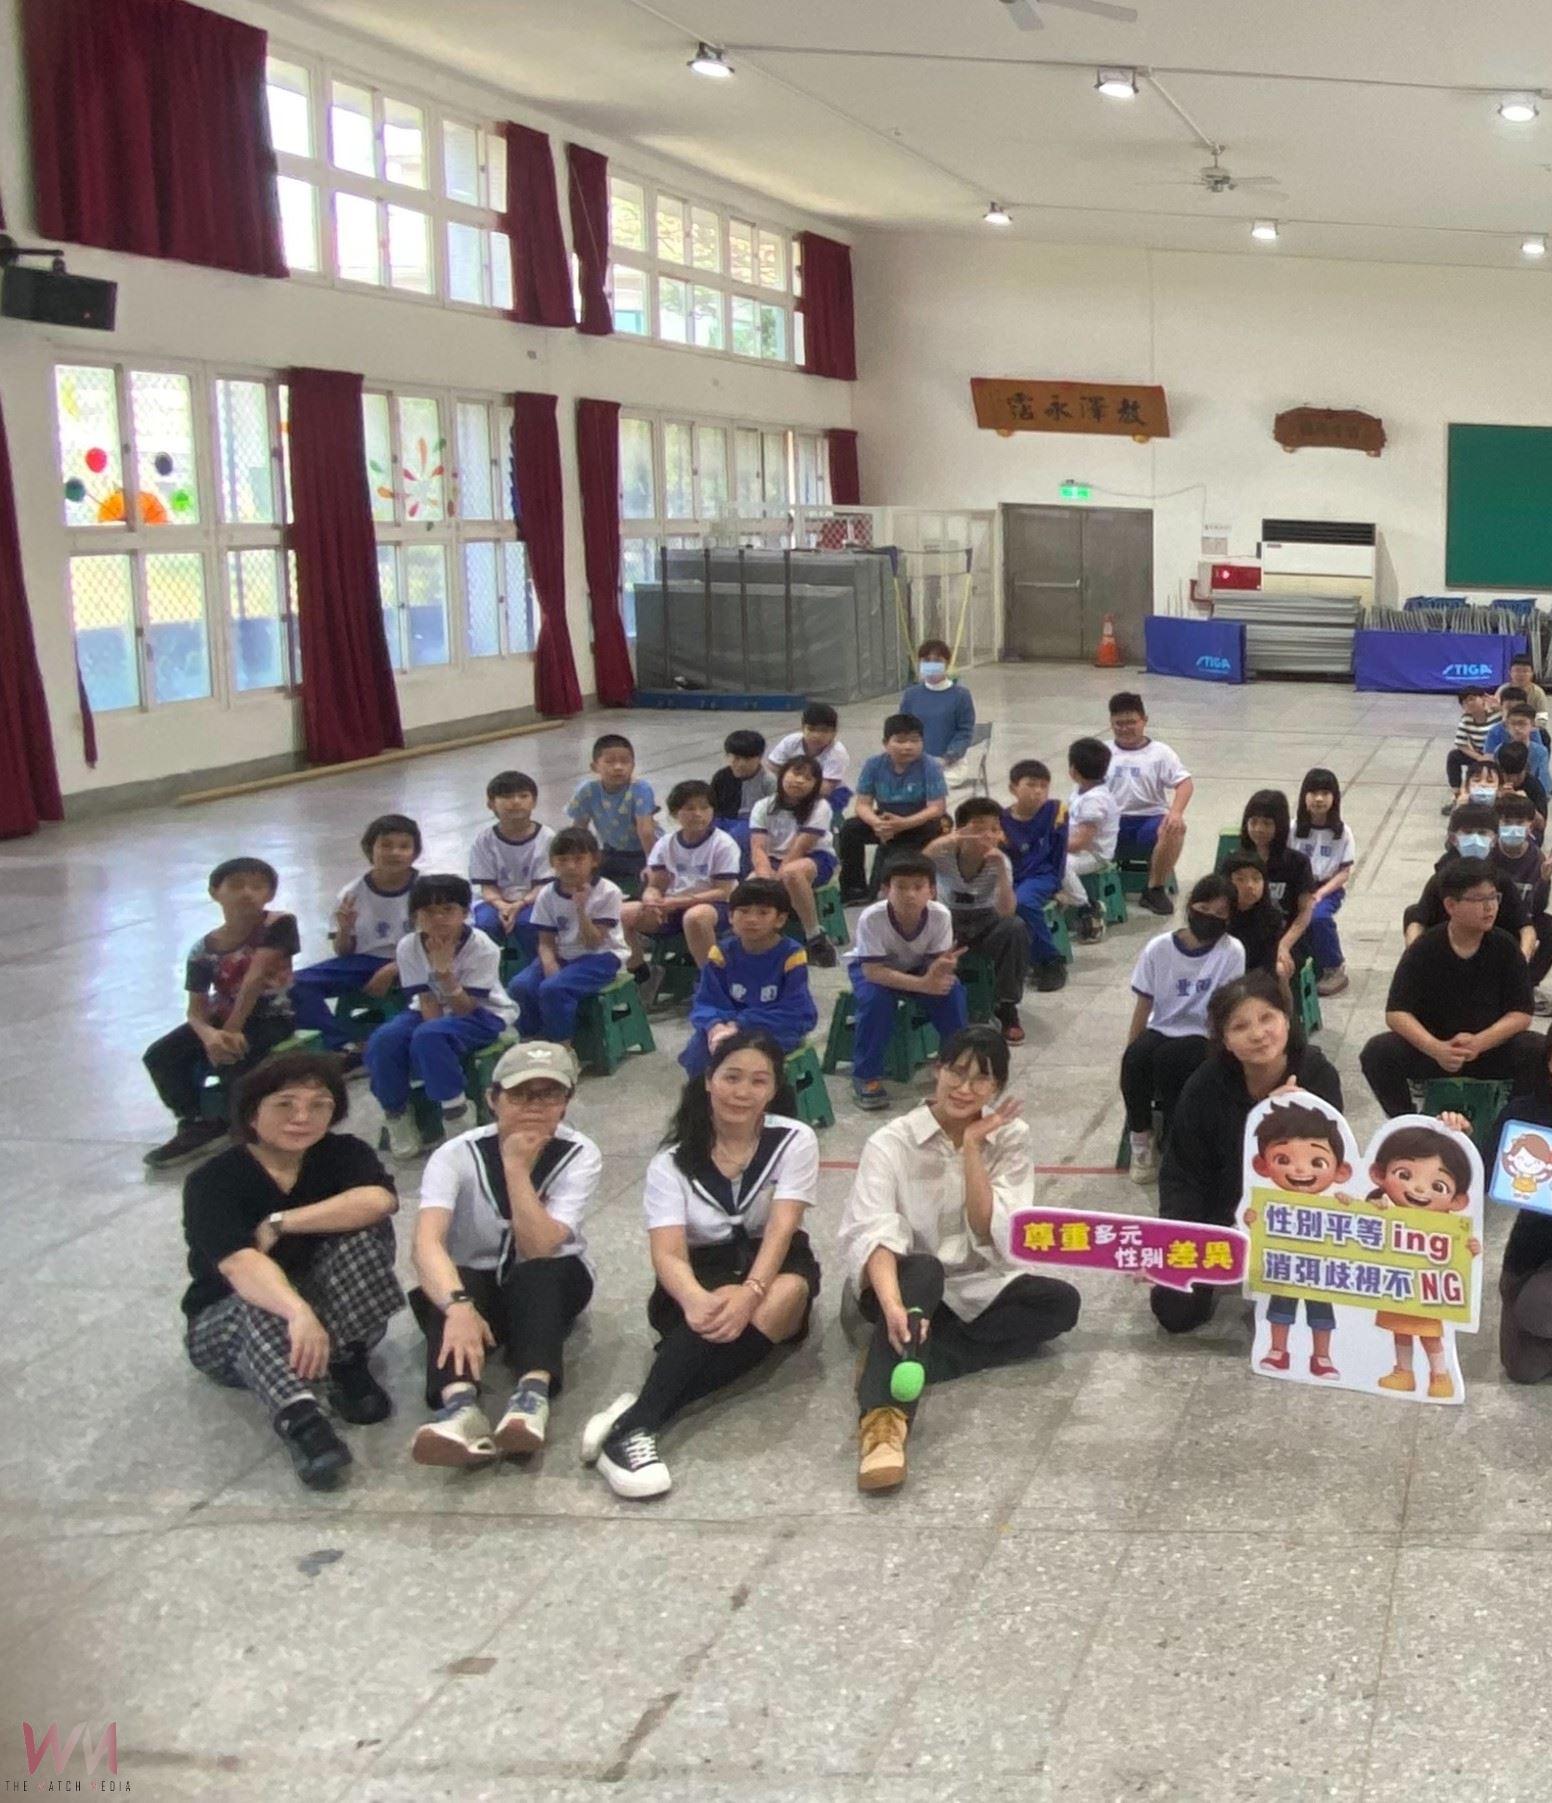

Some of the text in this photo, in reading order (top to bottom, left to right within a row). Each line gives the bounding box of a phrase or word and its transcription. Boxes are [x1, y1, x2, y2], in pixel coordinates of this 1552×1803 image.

[1265, 1203, 1450, 1261] 性別平等 ing
[1264, 1251, 1463, 1302] 消弭歧視不 NG
